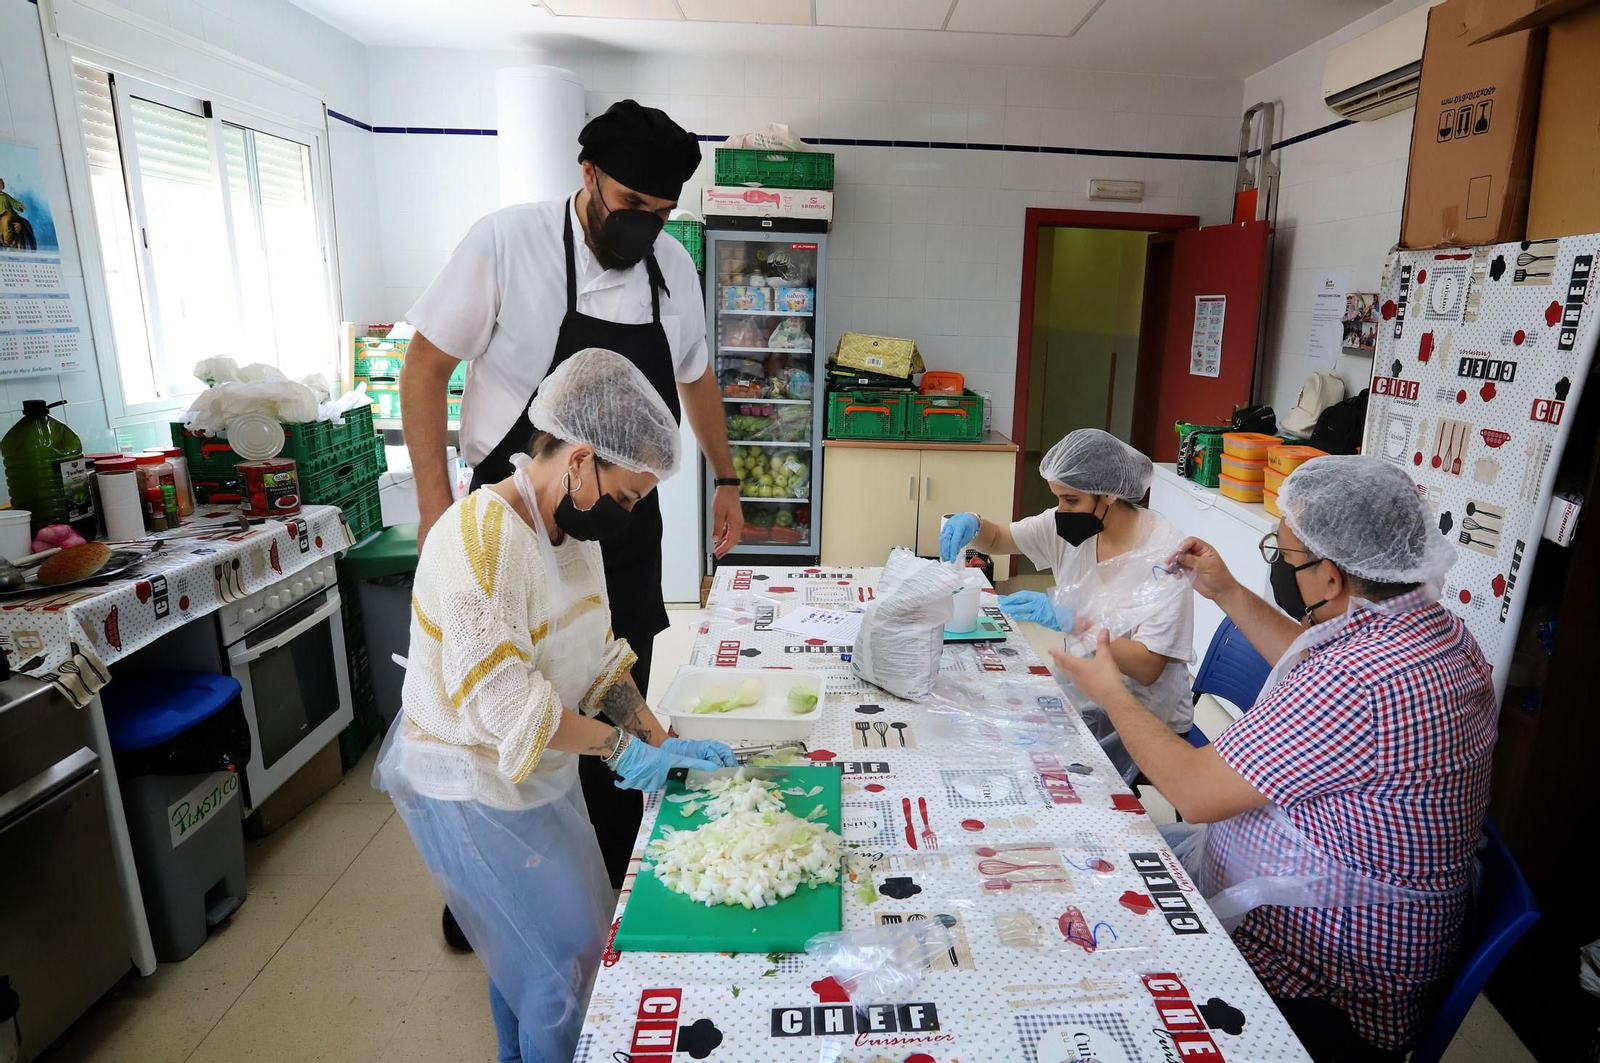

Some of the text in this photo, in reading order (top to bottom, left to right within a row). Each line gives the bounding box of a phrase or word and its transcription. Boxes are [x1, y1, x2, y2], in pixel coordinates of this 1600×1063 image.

[1454, 85, 1496, 104] 460x370x610
[1395, 268, 1411, 336] CHEF
[1559, 260, 1591, 347] CHEF
[1460, 358, 1515, 381] CHEF
[1534, 400, 1563, 424] CH
[298, 521, 309, 550] CH
[1557, 503, 1574, 542] aluminio
[153, 577, 169, 617] CH
[171, 775, 237, 836] PLASTICO
[1131, 858, 1202, 931] CHEF
[779, 1004, 928, 1035] CHEF
[1146, 978, 1217, 1057] CHE
[854, 1032, 955, 1047] Cuisinier
